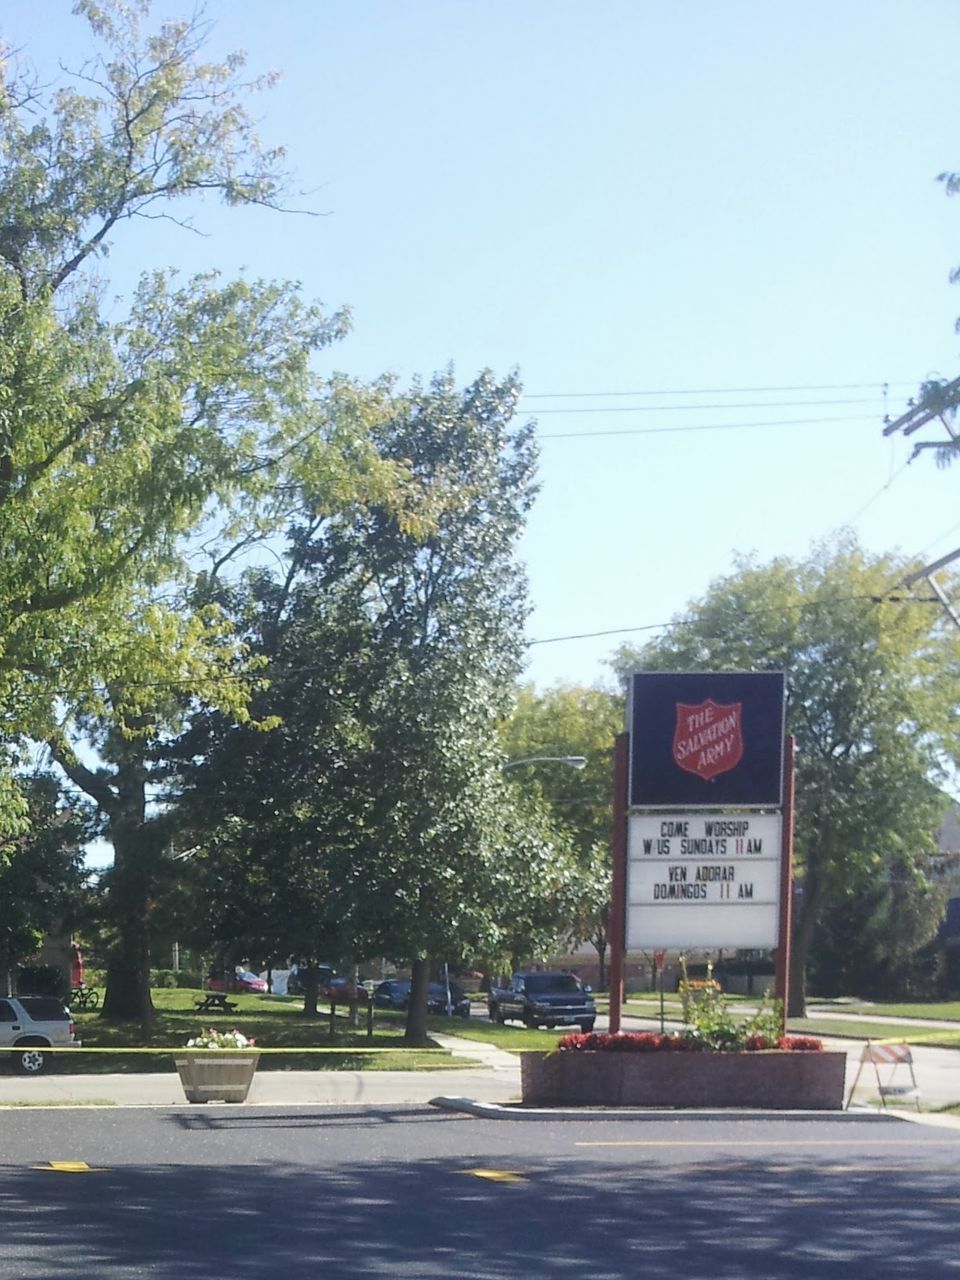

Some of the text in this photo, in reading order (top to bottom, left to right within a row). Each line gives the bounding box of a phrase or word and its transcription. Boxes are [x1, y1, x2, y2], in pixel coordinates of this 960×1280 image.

[687, 707, 714, 731] THE
[677, 711, 737, 760] SALVATION
[697, 734, 734, 770] ARMY
[660, 821, 749, 838] COME WORSHIP
[680, 839, 727, 854] SUNDAYS
[668, 866, 735, 882] VEN ADORAR
[653, 883, 753, 899] DOMINGOS 11 AM
